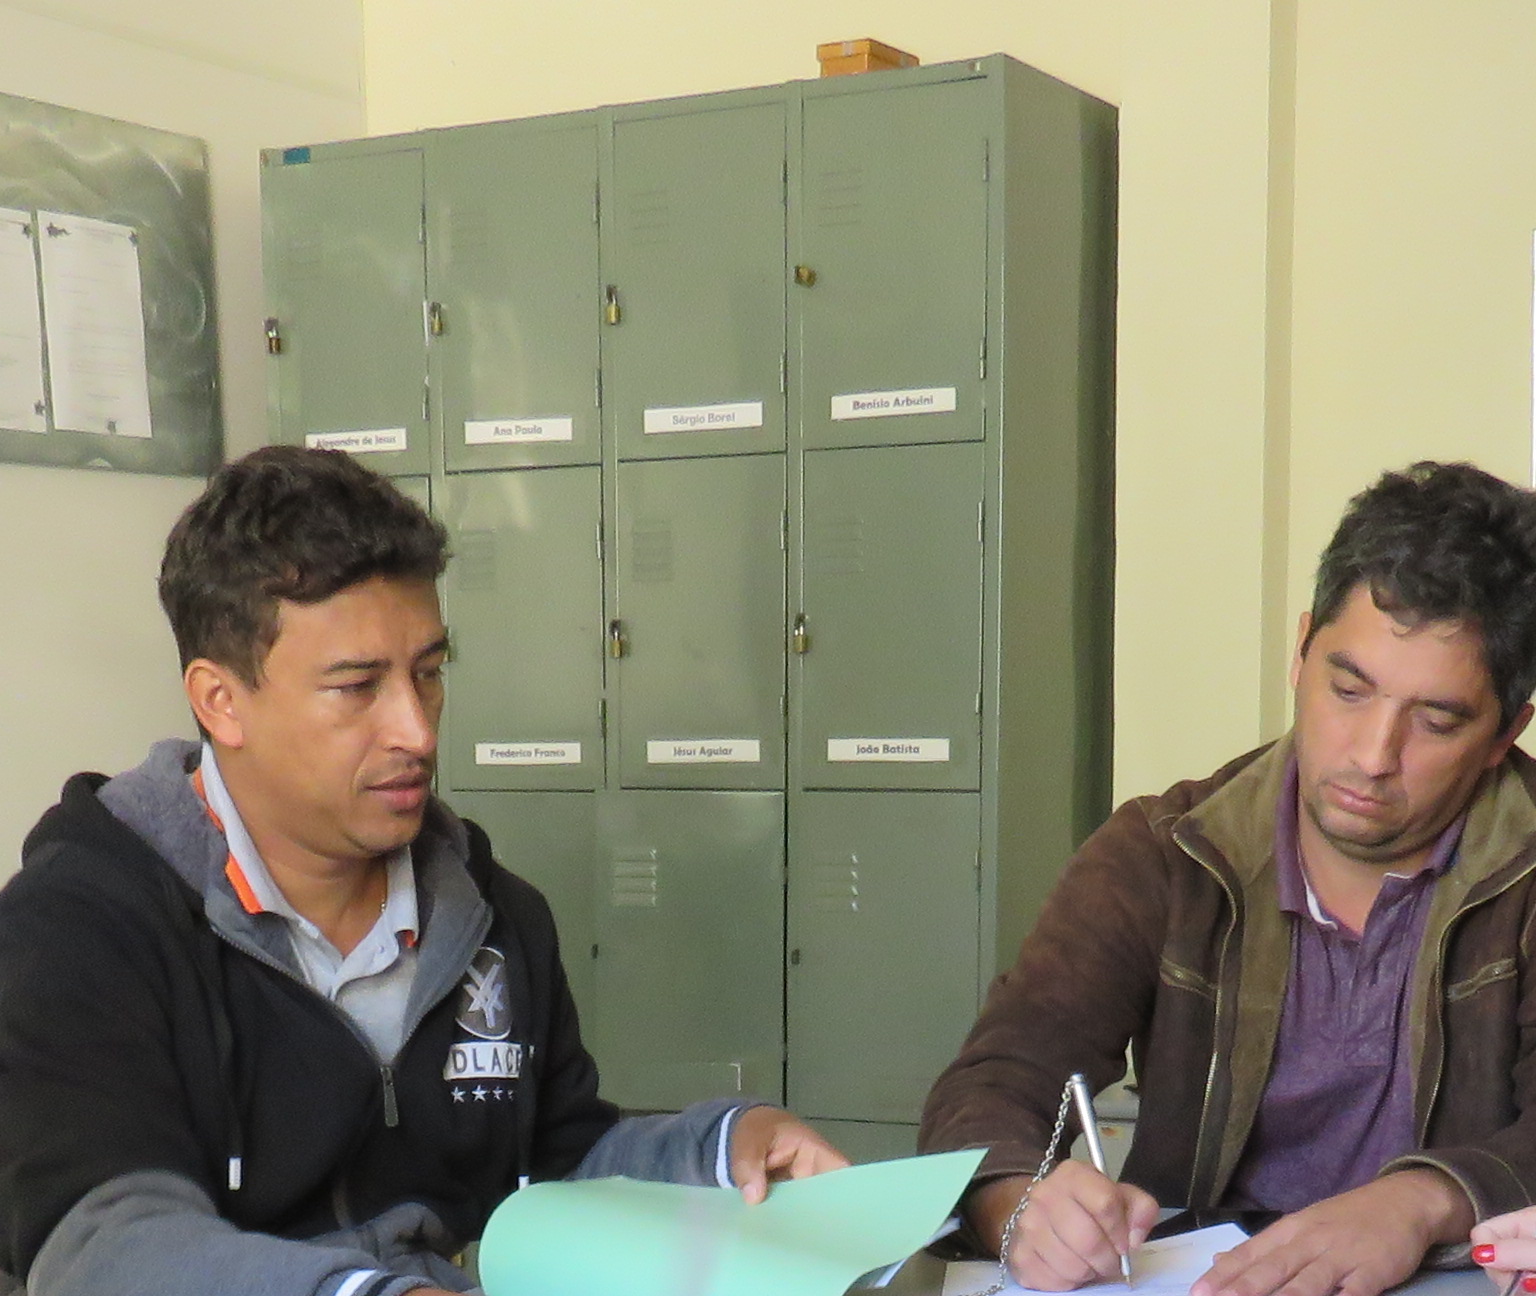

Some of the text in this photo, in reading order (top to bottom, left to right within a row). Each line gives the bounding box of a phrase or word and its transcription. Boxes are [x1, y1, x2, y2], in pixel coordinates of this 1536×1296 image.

[493, 424, 542, 436] Ana Paula
[699, 746, 732, 758] Aguiar
[856, 743, 920, 755] João Batista
